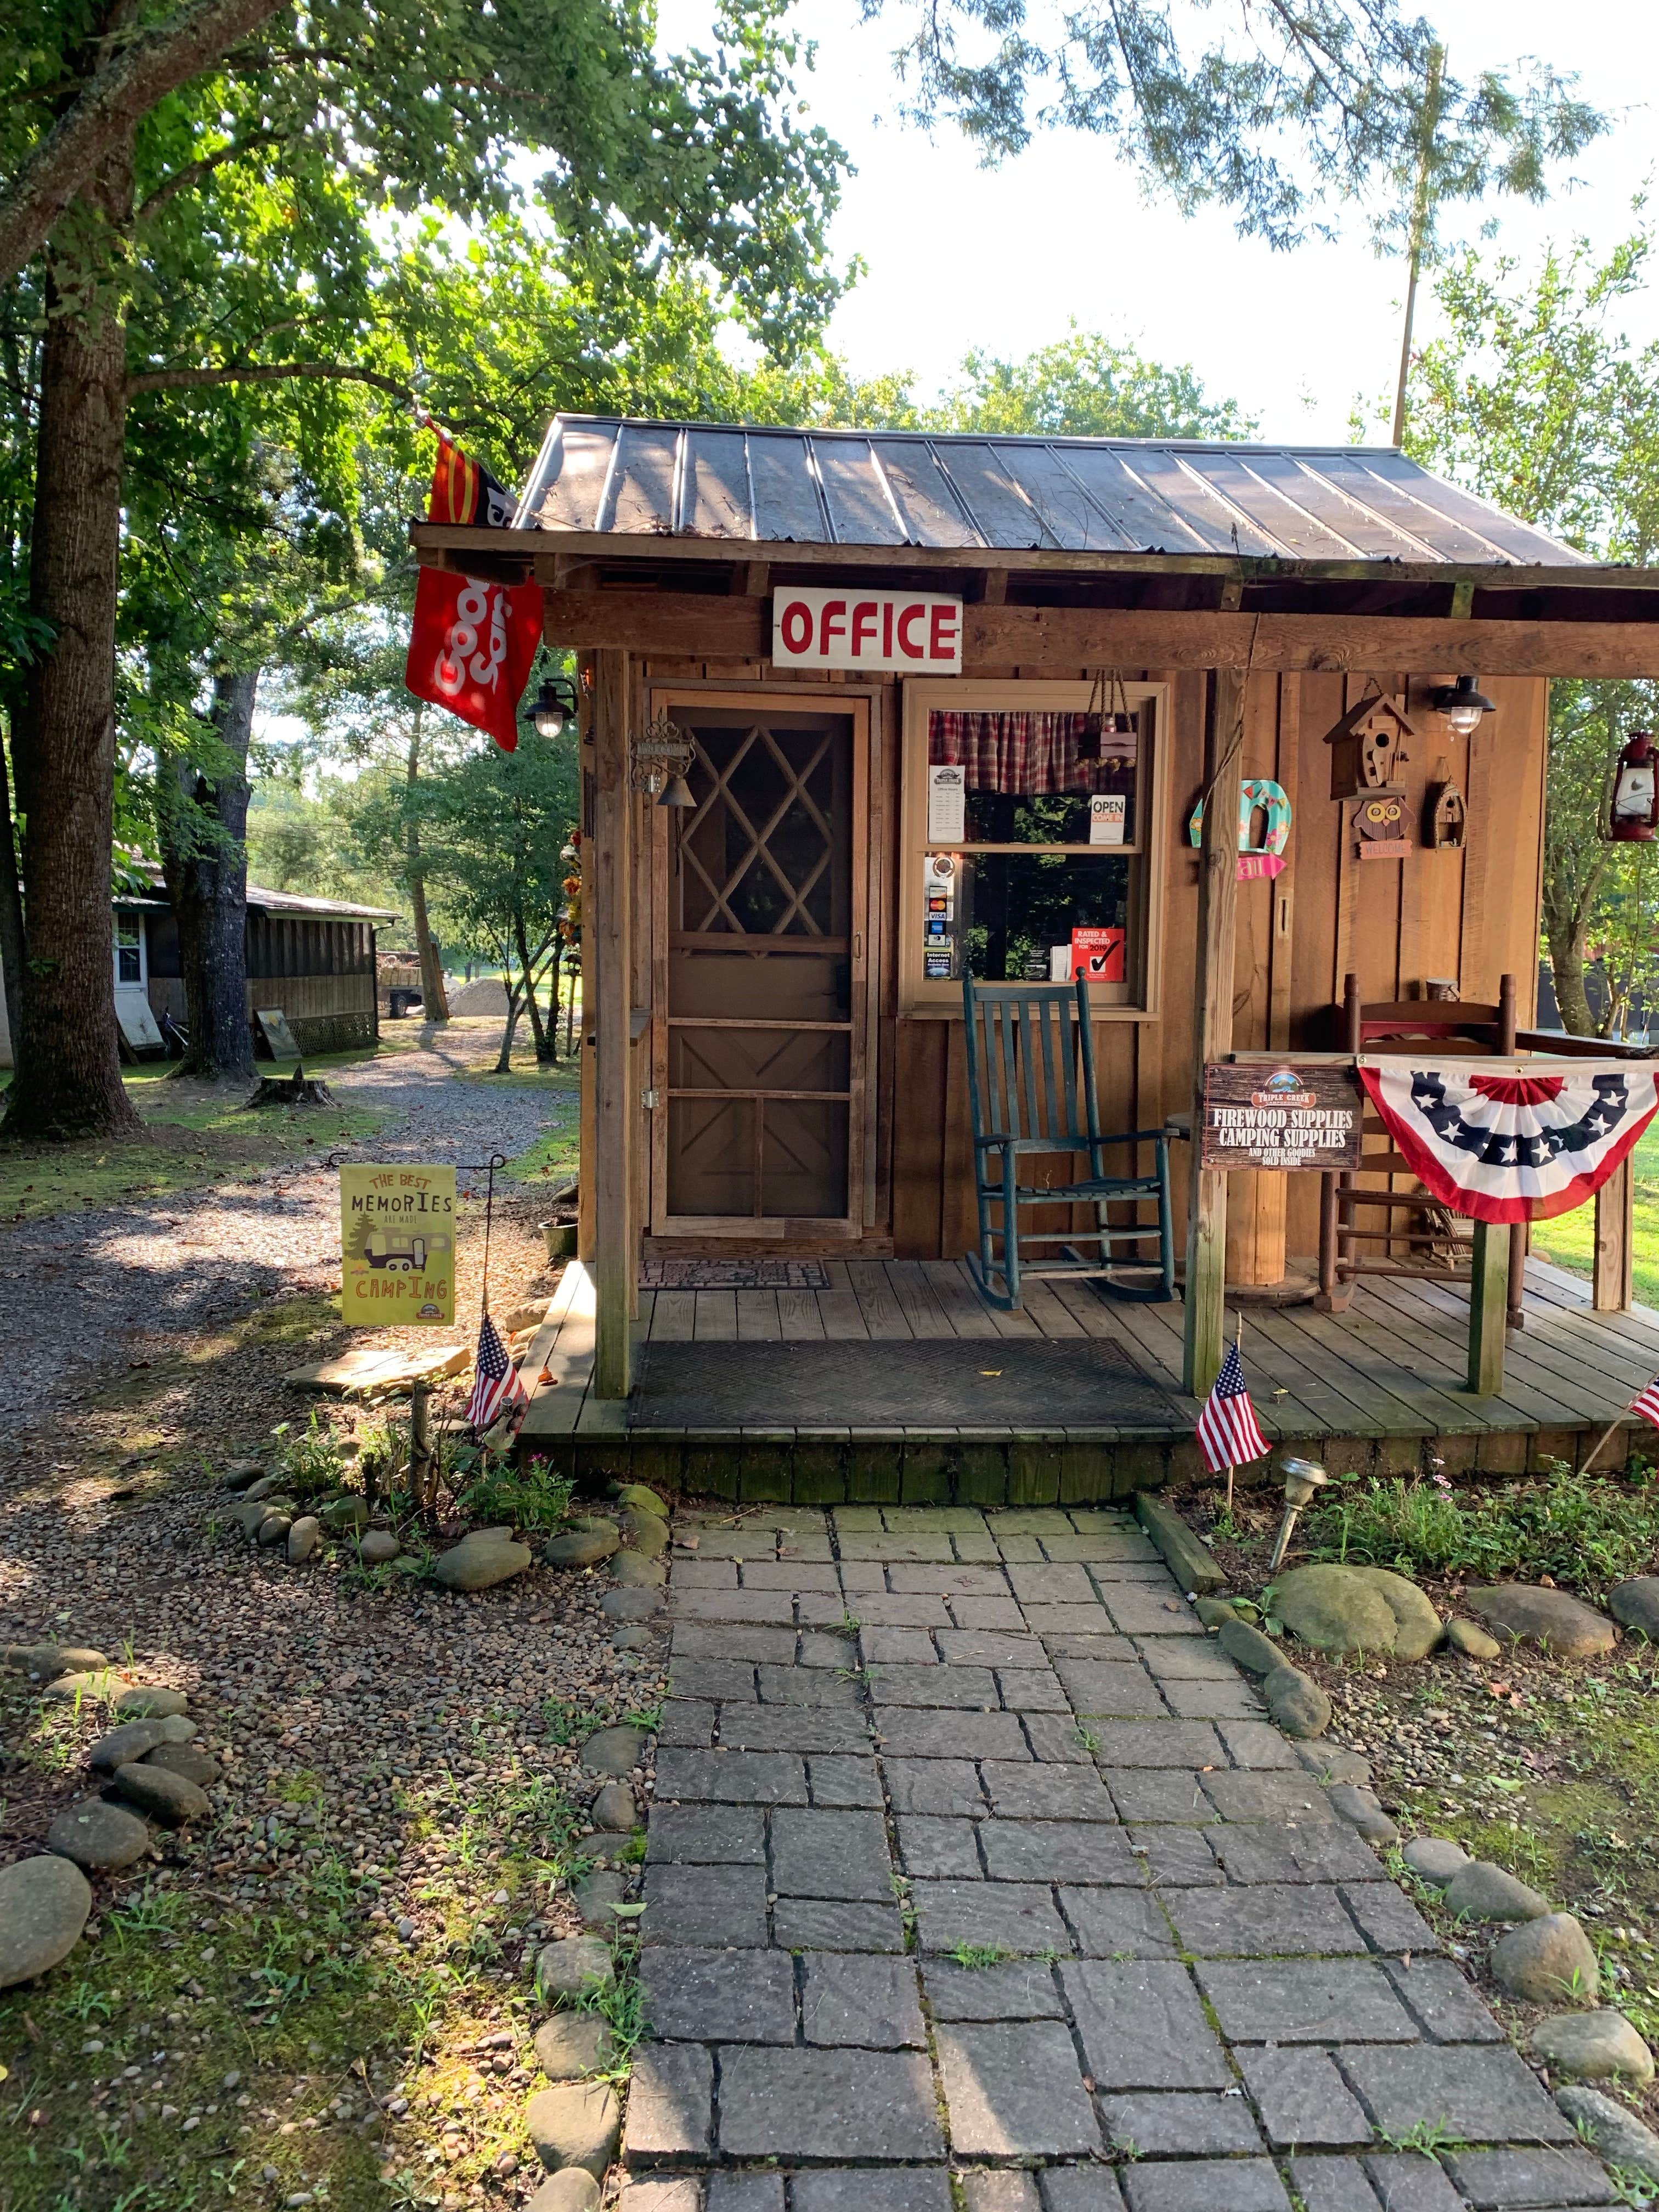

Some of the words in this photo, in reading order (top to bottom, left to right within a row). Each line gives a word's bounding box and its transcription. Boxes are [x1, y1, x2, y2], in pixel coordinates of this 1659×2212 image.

[781, 601, 956, 659] OFFICE
[1093, 801, 1124, 812] OPEN
[1366, 843, 1406, 854] WELCOME
[1259, 1094, 1283, 1103] TRIPLE
[1286, 1094, 1310, 1103] CREEK
[1214, 1109, 1287, 1127] FIREWOOD
[1291, 1109, 1353, 1128] SUPPLIES
[1220, 1128, 1280, 1147] CAMPING
[1284, 1128, 1346, 1148] SUPPLIES
[1249, 1148, 1262, 1156] AND
[1263, 1148, 1285, 1157] OTHER
[1288, 1148, 1316, 1157] GOODIES
[1262, 1156, 1279, 1165] SOLD
[1280, 1156, 1301, 1166] INSIDE
[369, 1173, 394, 1189] THE
[400, 1173, 432, 1189] BEST
[352, 1192, 452, 1212] MEMORIES
[384, 1215, 395, 1223] ARE
[399, 1215, 416, 1224] MADE
[356, 1276, 447, 1299] CAMPING
